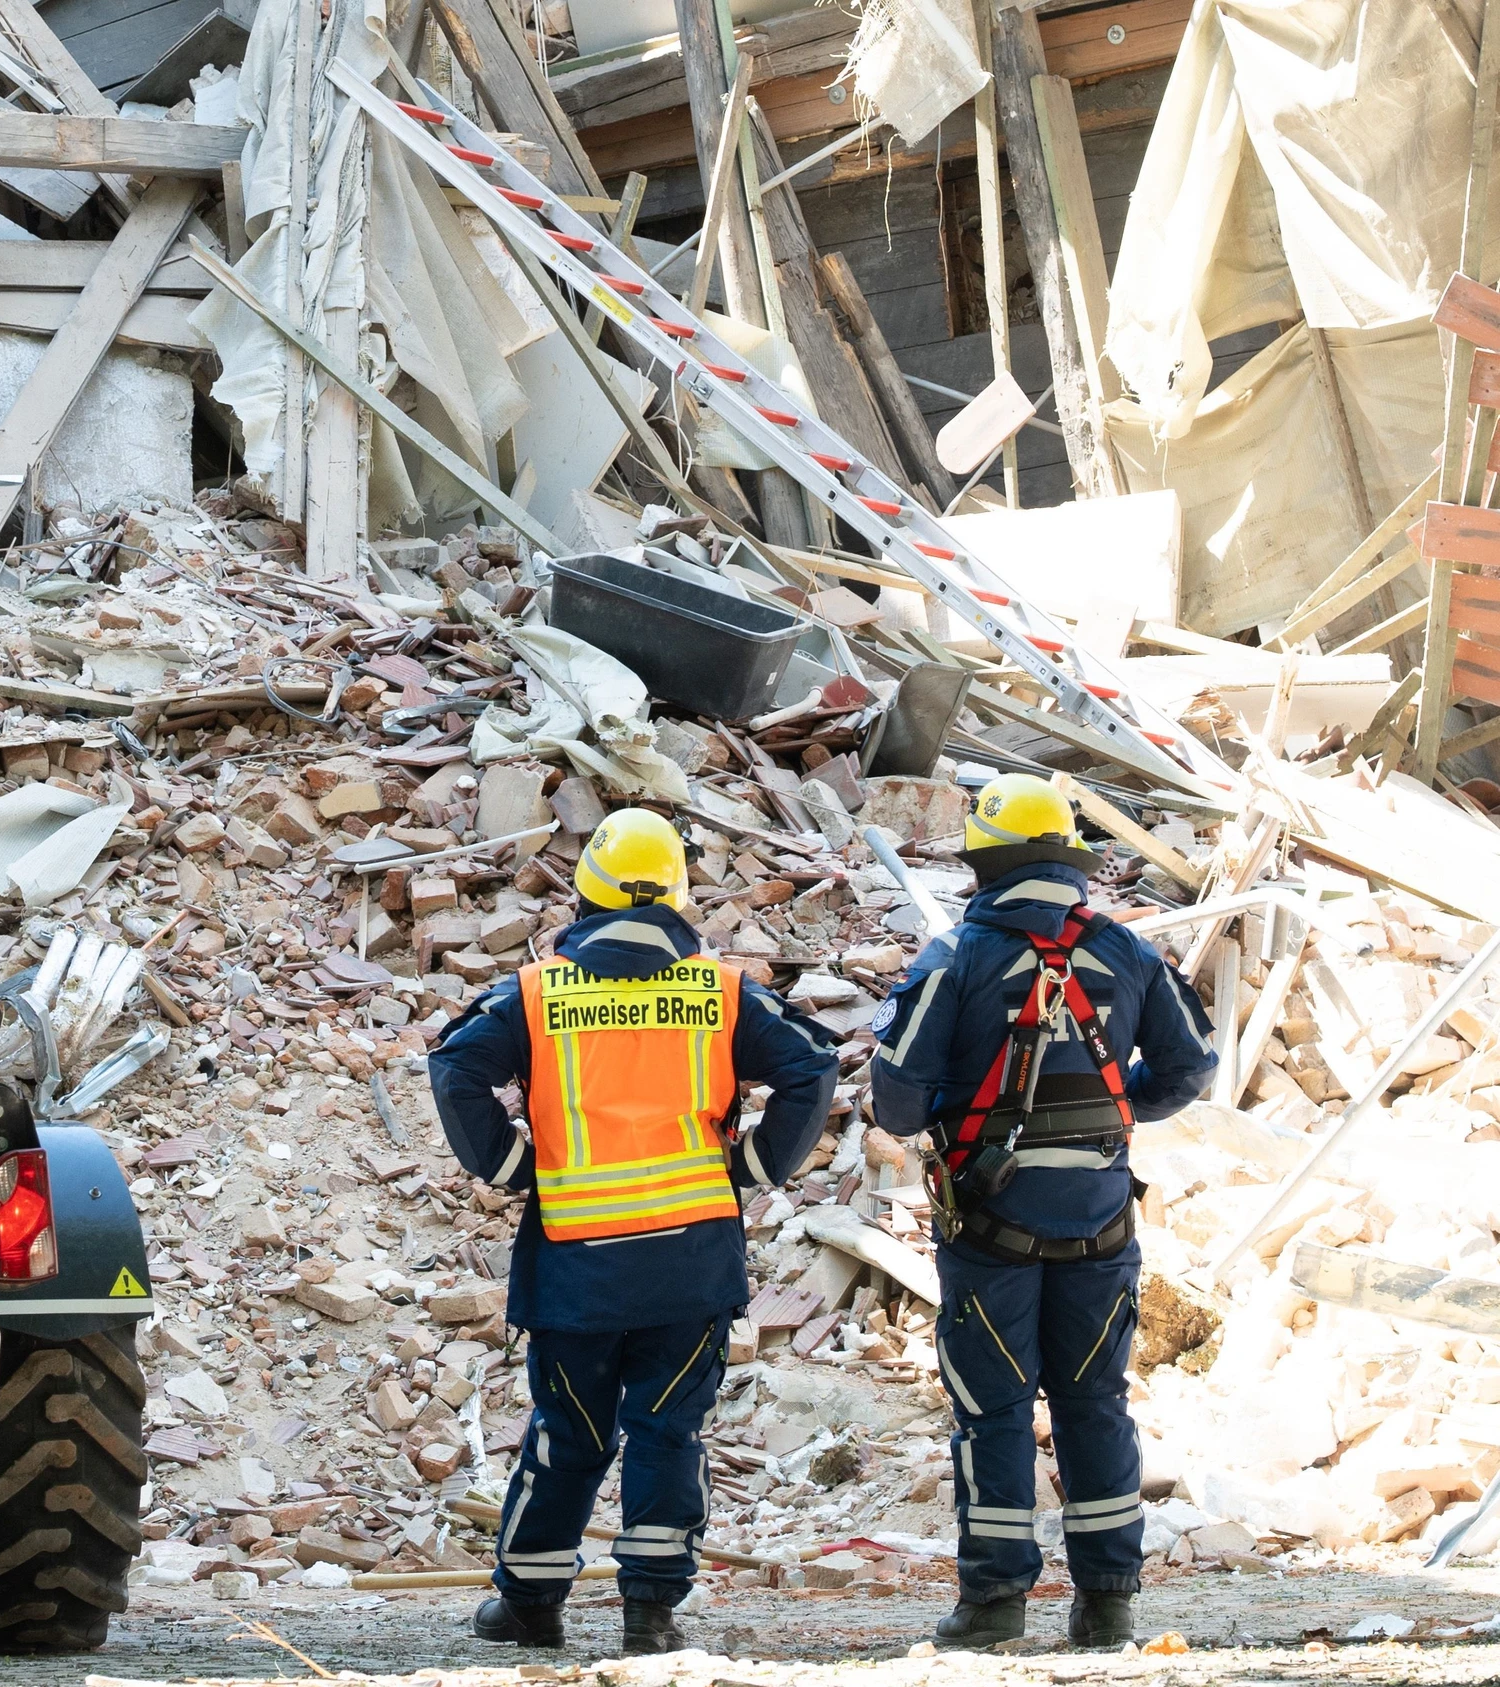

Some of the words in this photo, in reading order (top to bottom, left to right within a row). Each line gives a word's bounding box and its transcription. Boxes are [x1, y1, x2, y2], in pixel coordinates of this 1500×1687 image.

[546, 965, 602, 988] THW
[613, 965, 716, 989] berg
[548, 998, 650, 1030] Einweiser
[656, 997, 719, 1027] BRmG
[1017, 1052, 1030, 1091] SKYLOTEC
